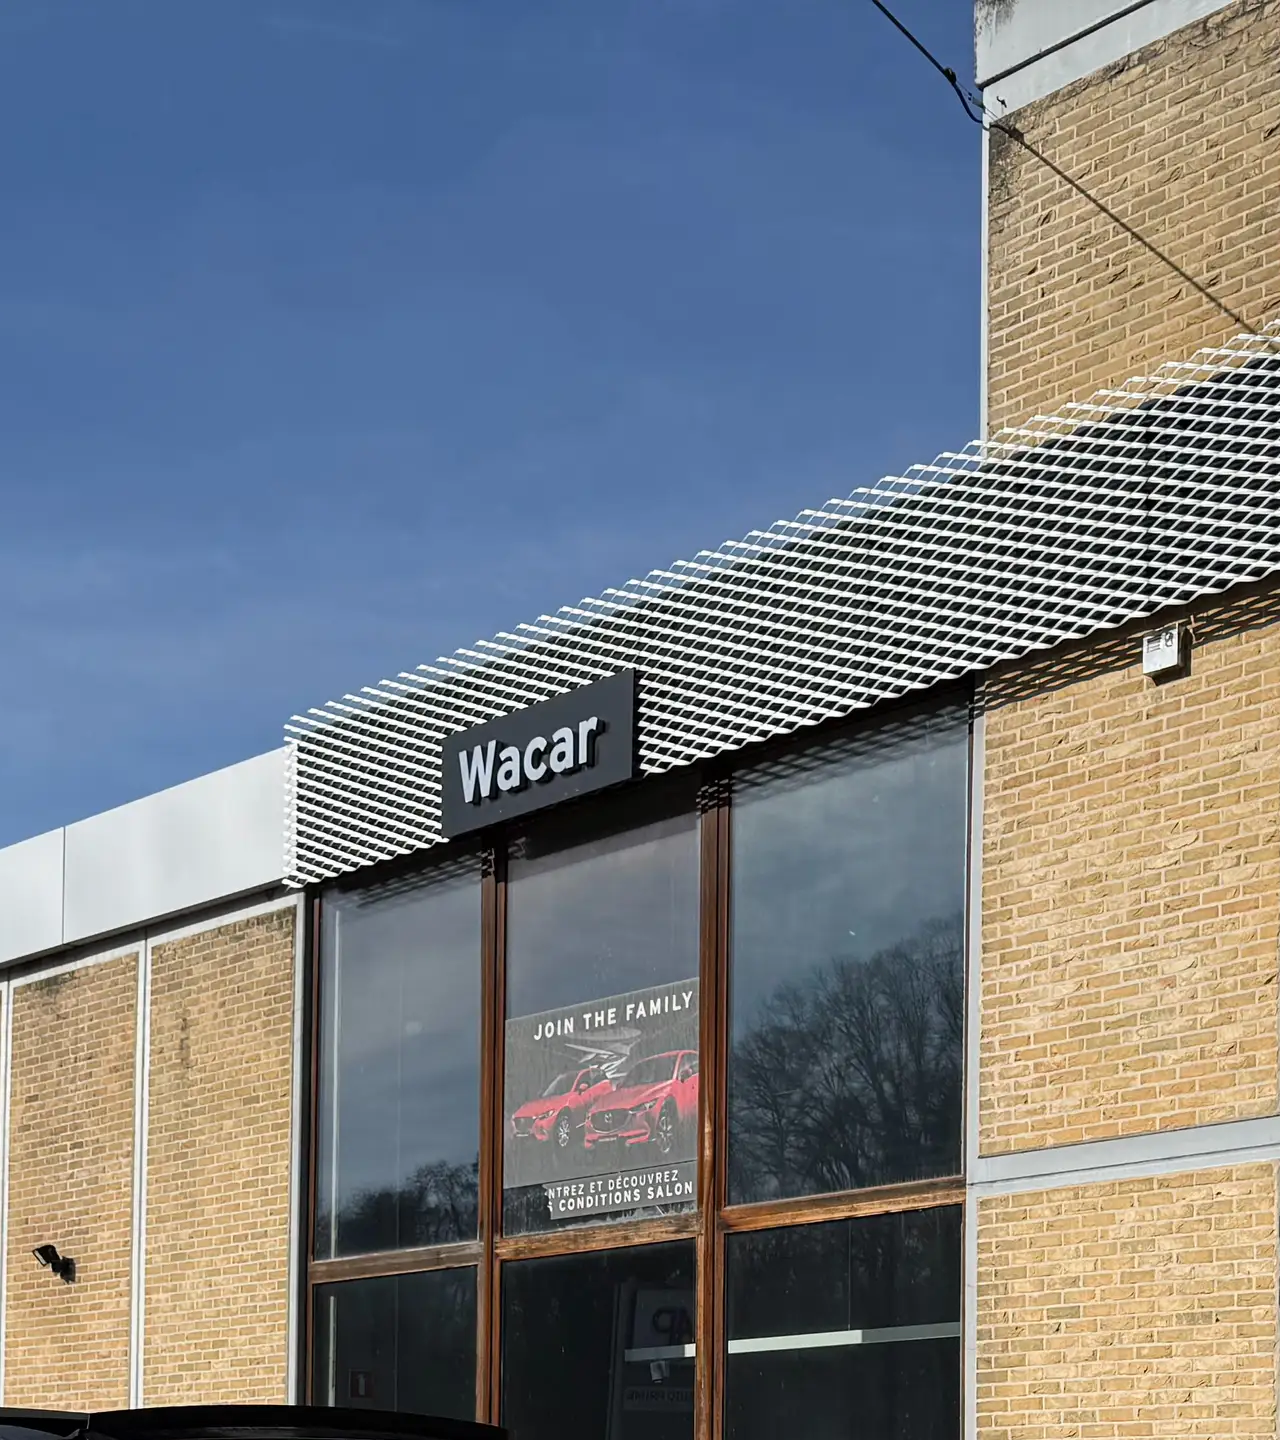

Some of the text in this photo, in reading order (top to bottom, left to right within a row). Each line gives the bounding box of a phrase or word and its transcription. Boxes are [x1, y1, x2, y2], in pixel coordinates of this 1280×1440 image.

[459, 714, 598, 804] Wacar
[533, 991, 693, 1041] JOIN THE FAMILY
[546, 1169, 679, 1200] NTREZ ET DÉCOUVREZ
[558, 1189, 641, 1212] CONDITIONS
[647, 1181, 693, 1200] SALON
